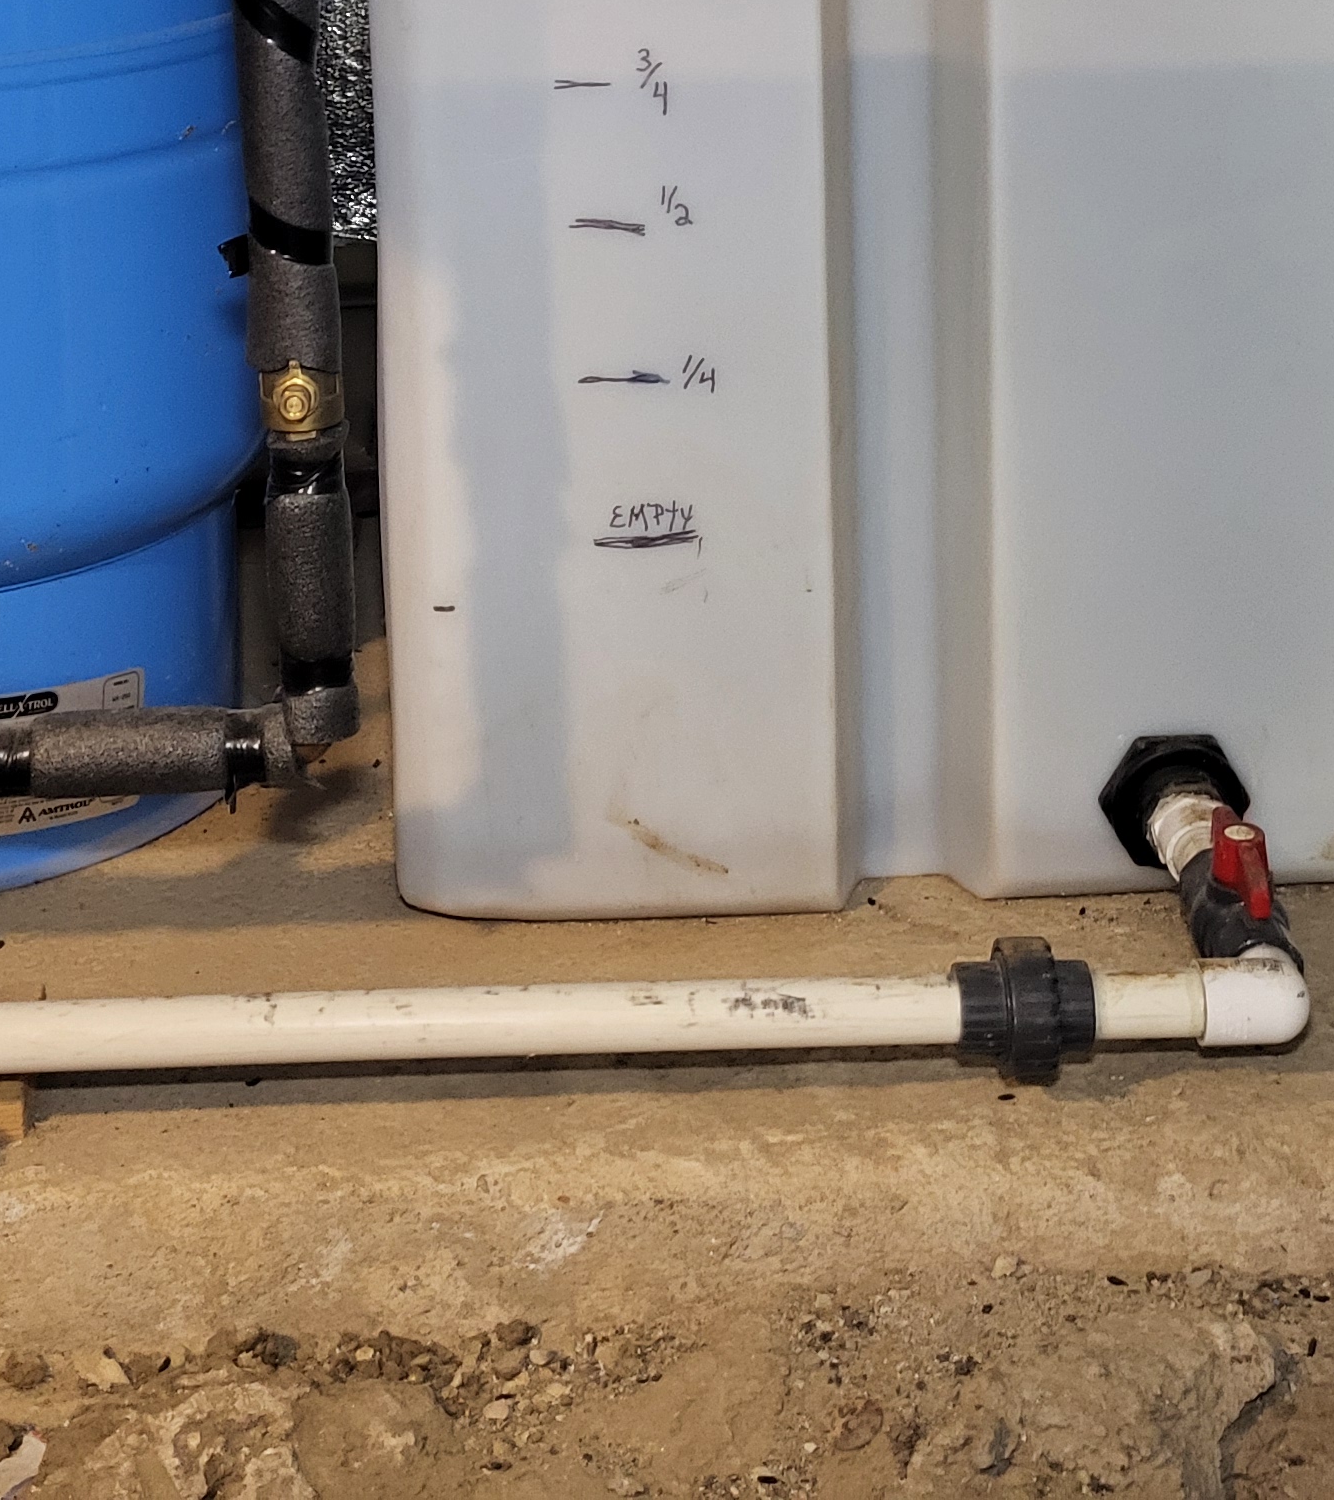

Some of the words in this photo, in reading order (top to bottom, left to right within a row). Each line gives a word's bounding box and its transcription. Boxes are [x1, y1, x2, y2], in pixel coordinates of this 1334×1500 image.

[636, 48, 669, 115] 3/4
[660, 186, 693, 227] 1/2
[682, 355, 717, 393] 1/4
[609, 500, 695, 531] EMPTY
